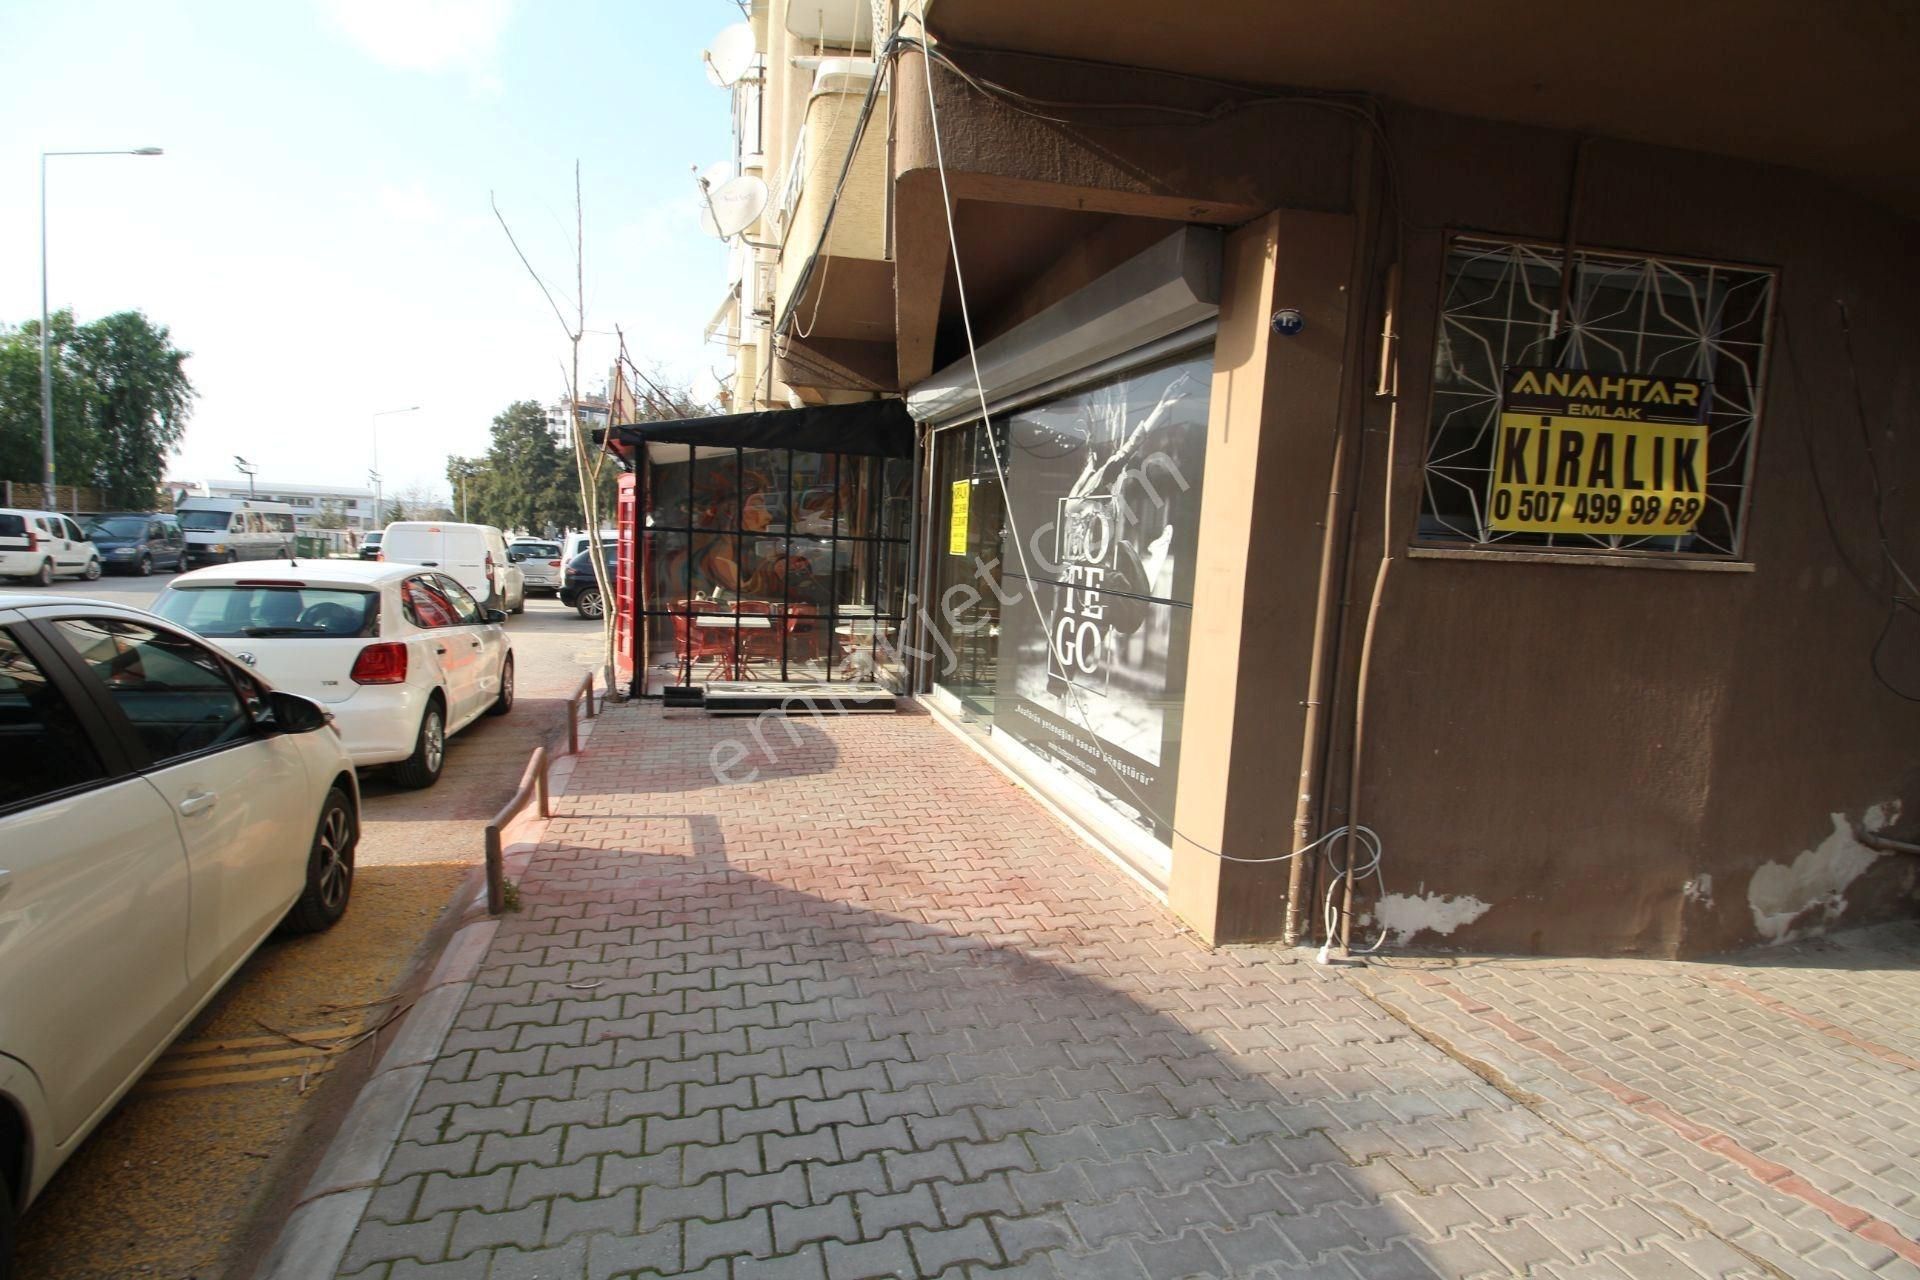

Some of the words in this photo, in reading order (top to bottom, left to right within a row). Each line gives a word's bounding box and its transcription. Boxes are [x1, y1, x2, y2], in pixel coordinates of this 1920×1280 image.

[1511, 370, 1700, 407] ANAHTAR
[1567, 403, 1641, 421] EMLAK
[1500, 416, 1700, 493] KİRALIK
[1494, 489, 1511, 521] 0
[1518, 490, 1565, 523] 507
[1573, 492, 1622, 525] 499
[1627, 495, 1661, 526] 98
[1664, 497, 1700, 527] 68
[1062, 564, 1105, 620] TE
[1055, 616, 1102, 674] GO
